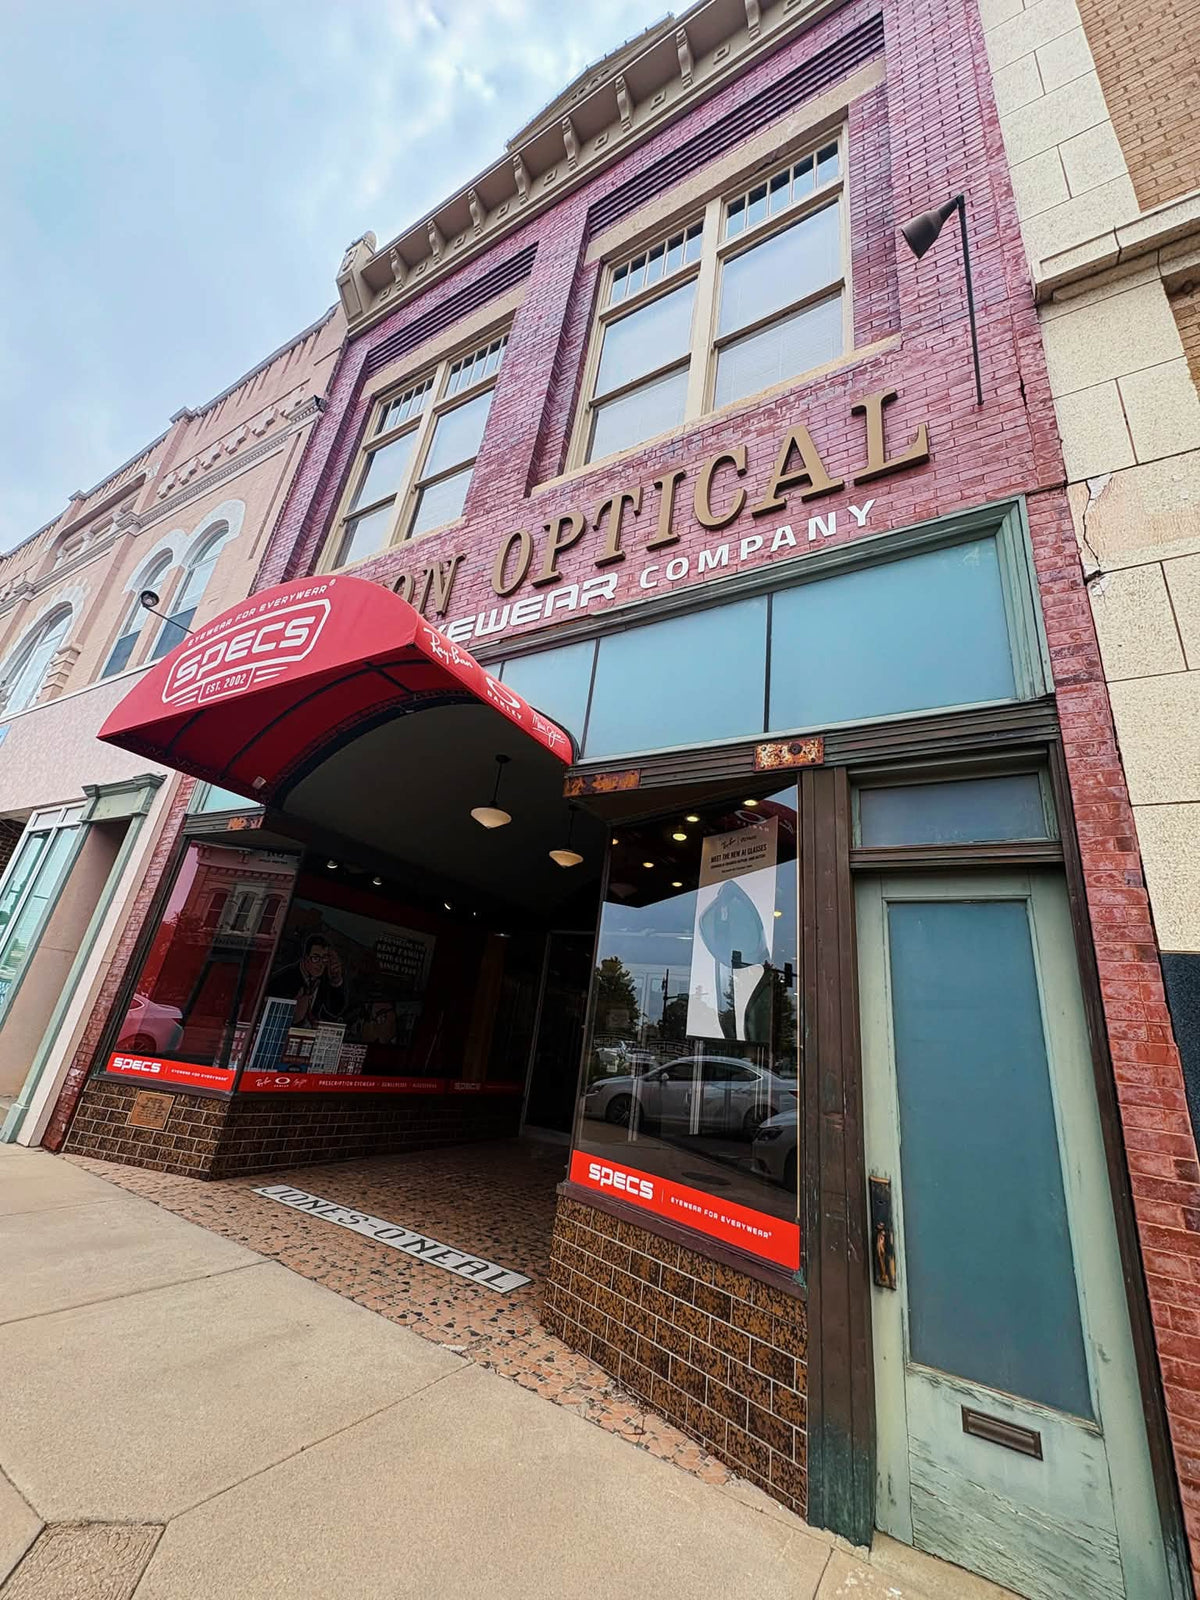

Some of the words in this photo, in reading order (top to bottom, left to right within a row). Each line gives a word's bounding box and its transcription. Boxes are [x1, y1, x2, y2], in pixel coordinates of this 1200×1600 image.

[391, 552, 466, 621] ON
[491, 388, 931, 598] OPTICAL
[439, 571, 617, 642] EWEAR
[639, 499, 877, 590] COMPANY
[172, 615, 317, 689] SPECS
[188, 618, 233, 647] EYEWEAR
[235, 607, 257, 622] FOR
[423, 627, 474, 668] Ray-Ban
[205, 681, 222, 695] EST.
[224, 673, 248, 689] 2002
[487, 689, 522, 719] OAKLEY
[112, 1056, 162, 1074] SPECS
[588, 1162, 654, 1201] SPECS
[670, 1196, 702, 1214] EYEWEAR
[704, 1208, 719, 1221] FOR
[260, 1187, 513, 1289] JONES-O'NEAL
